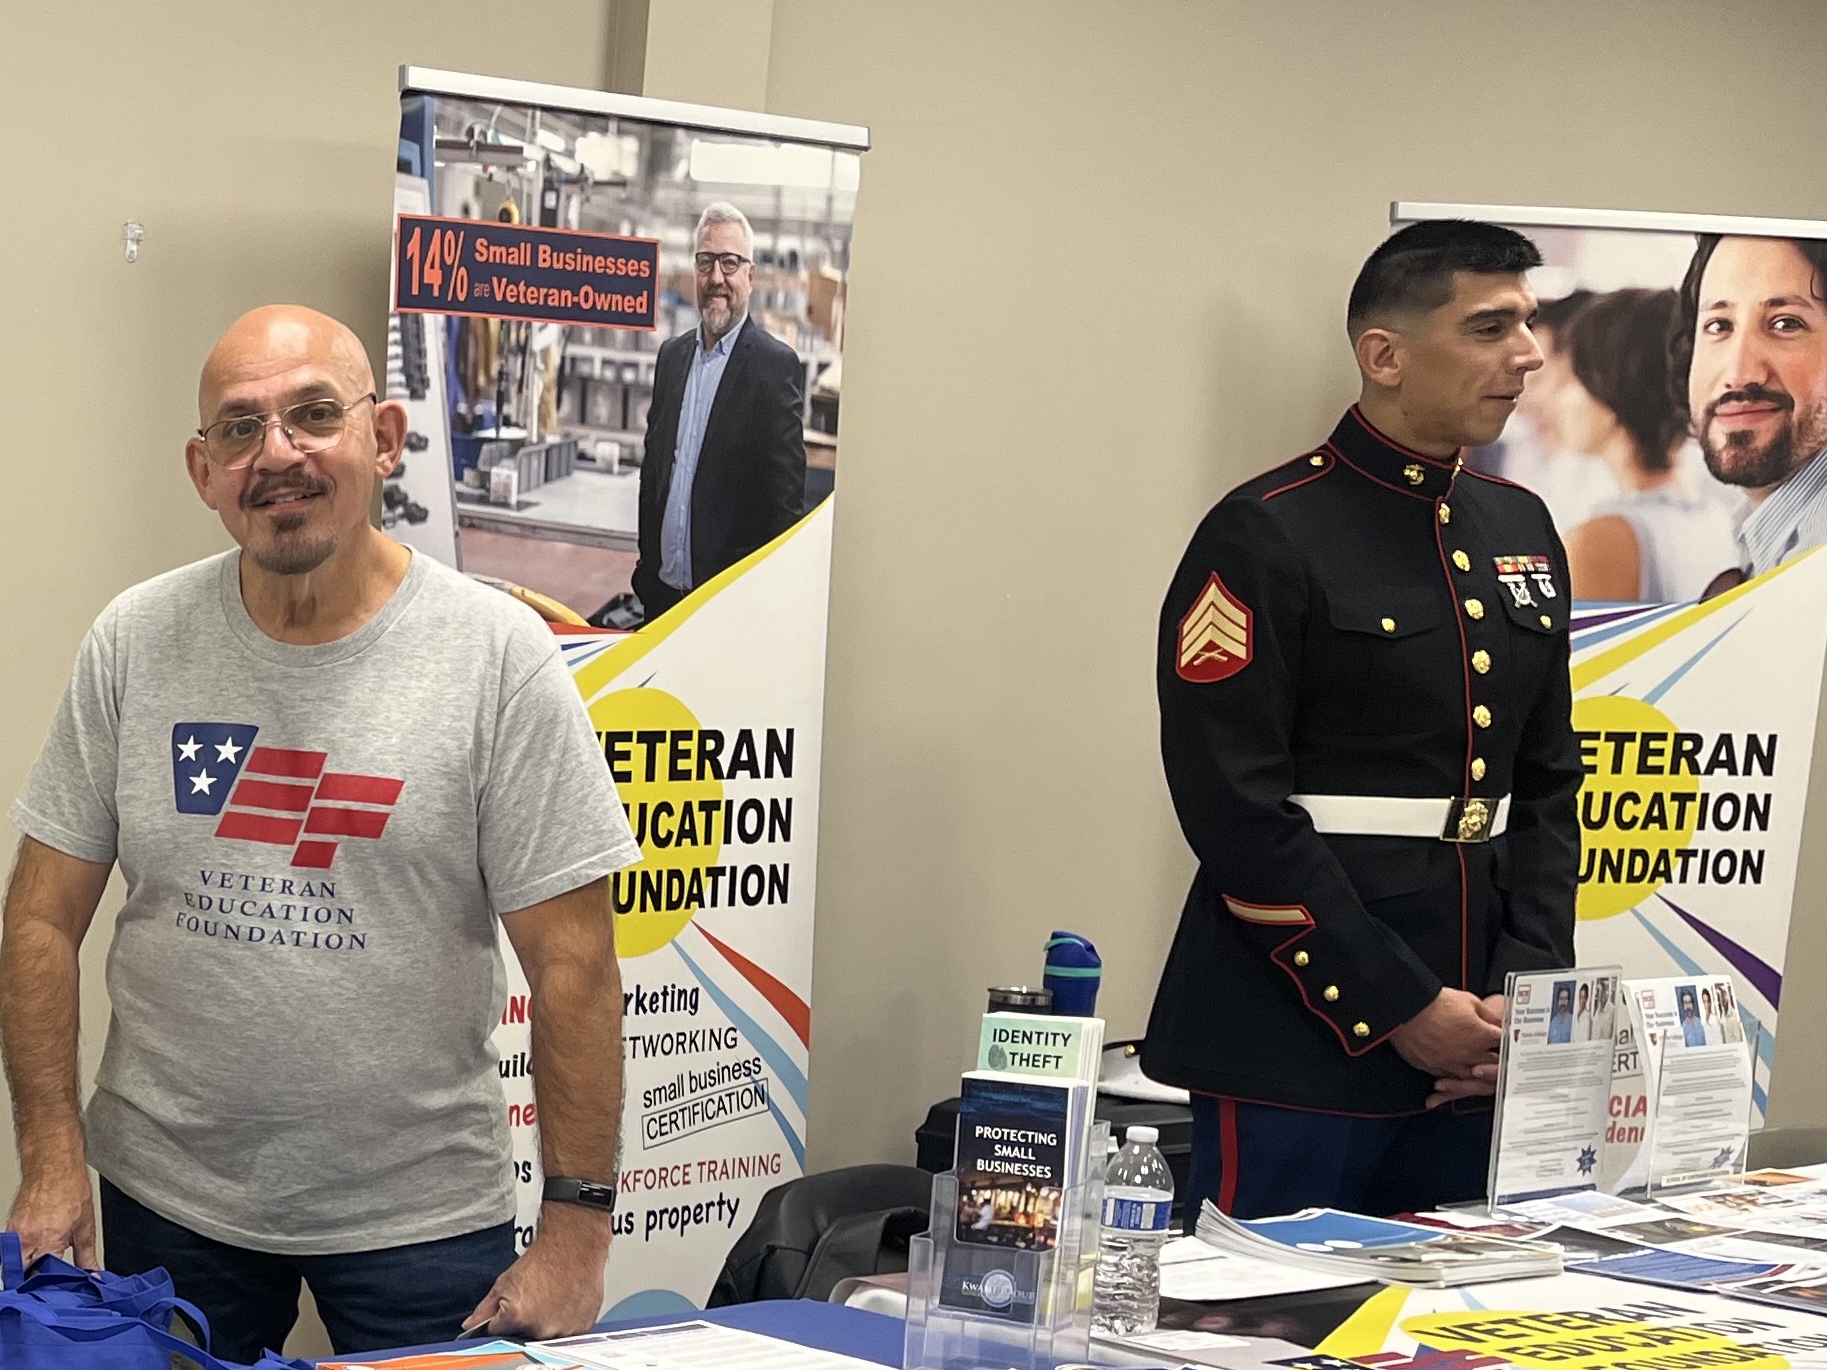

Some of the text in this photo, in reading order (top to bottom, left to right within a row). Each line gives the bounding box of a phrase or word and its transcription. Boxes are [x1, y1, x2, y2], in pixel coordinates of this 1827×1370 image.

[405, 226, 468, 302] 14%
[473, 238, 651, 279] Small Businesses
[474, 276, 649, 315] are Veteran-Owned
[596, 728, 794, 784] ETERAN
[1576, 731, 1778, 777] ETERAN
[622, 798, 793, 850] UCATION
[1581, 792, 1772, 832] UCATION
[200, 869, 337, 899] VETERAN
[1576, 848, 1765, 885] UNDATION
[183, 892, 355, 925] EDUCATION
[612, 863, 791, 915] UNDATION
[175, 911, 368, 950] FOUNDATION
[623, 984, 700, 1020] rketing
[623, 1027, 739, 1061] TWORKING
[992, 1028, 1073, 1048] IDENTITY
[1009, 1051, 1063, 1071] THEFT
[642, 1056, 762, 1110] small business
[646, 1085, 766, 1142] CERTIFICATION
[975, 1125, 1058, 1147] PROTECTING
[994, 1144, 1036, 1161] SMALL
[619, 1153, 782, 1194] KFORCE TRAINING
[976, 1159, 1052, 1179] BUSINESSES
[645, 1196, 740, 1244] property
[1412, 1300, 1707, 1343] VETERAN
[1504, 1318, 1789, 1363] EDUCATION
